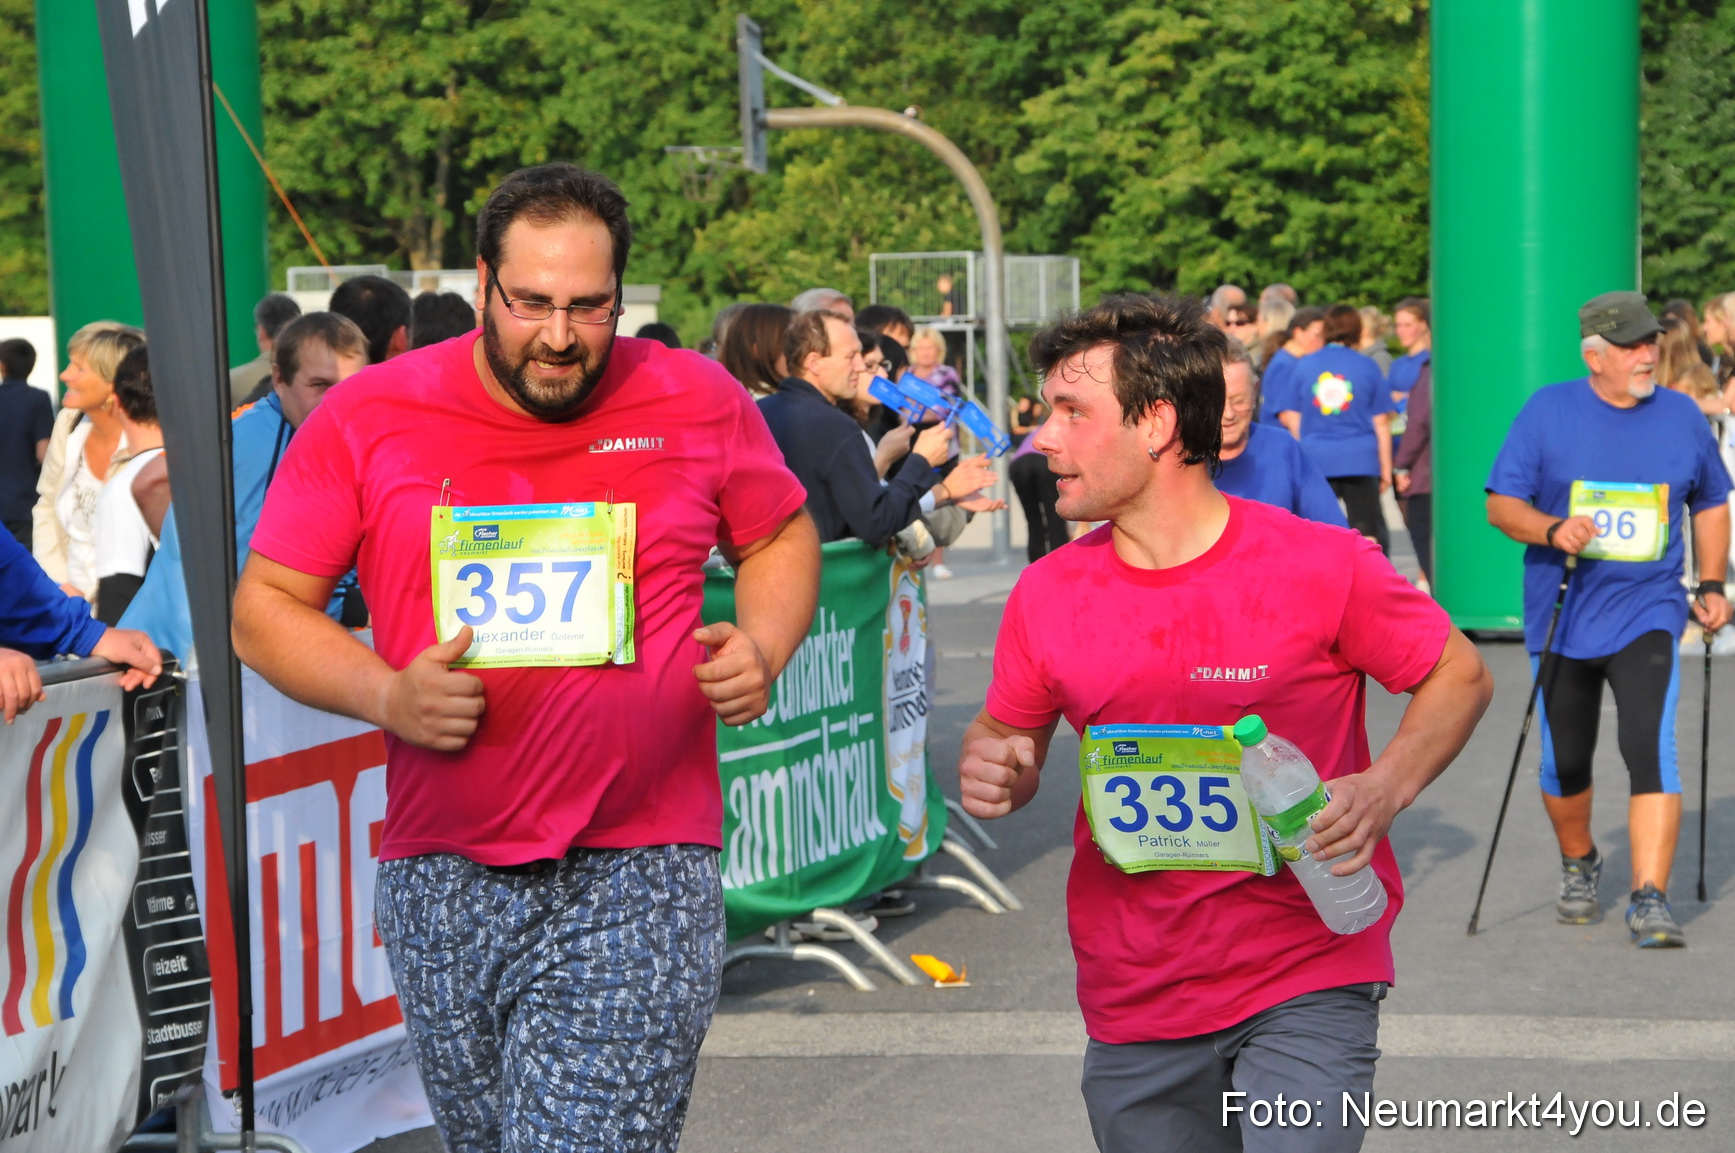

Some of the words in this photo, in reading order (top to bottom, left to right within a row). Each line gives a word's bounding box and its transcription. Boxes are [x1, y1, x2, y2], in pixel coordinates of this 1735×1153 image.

[602, 437, 665, 451] DAHMIT
[1594, 509, 1636, 540] 96
[460, 537, 524, 551] firmenlauf
[455, 560, 592, 626] 357
[550, 633, 584, 641] Özdemir
[495, 646, 553, 655] Garagen-Runners
[1202, 664, 1268, 680] DAHMIT
[1103, 753, 1163, 766] firmenlauf
[1104, 775, 1239, 833] 335
[1138, 835, 1192, 848] Patrick
[1196, 840, 1221, 848] Müller
